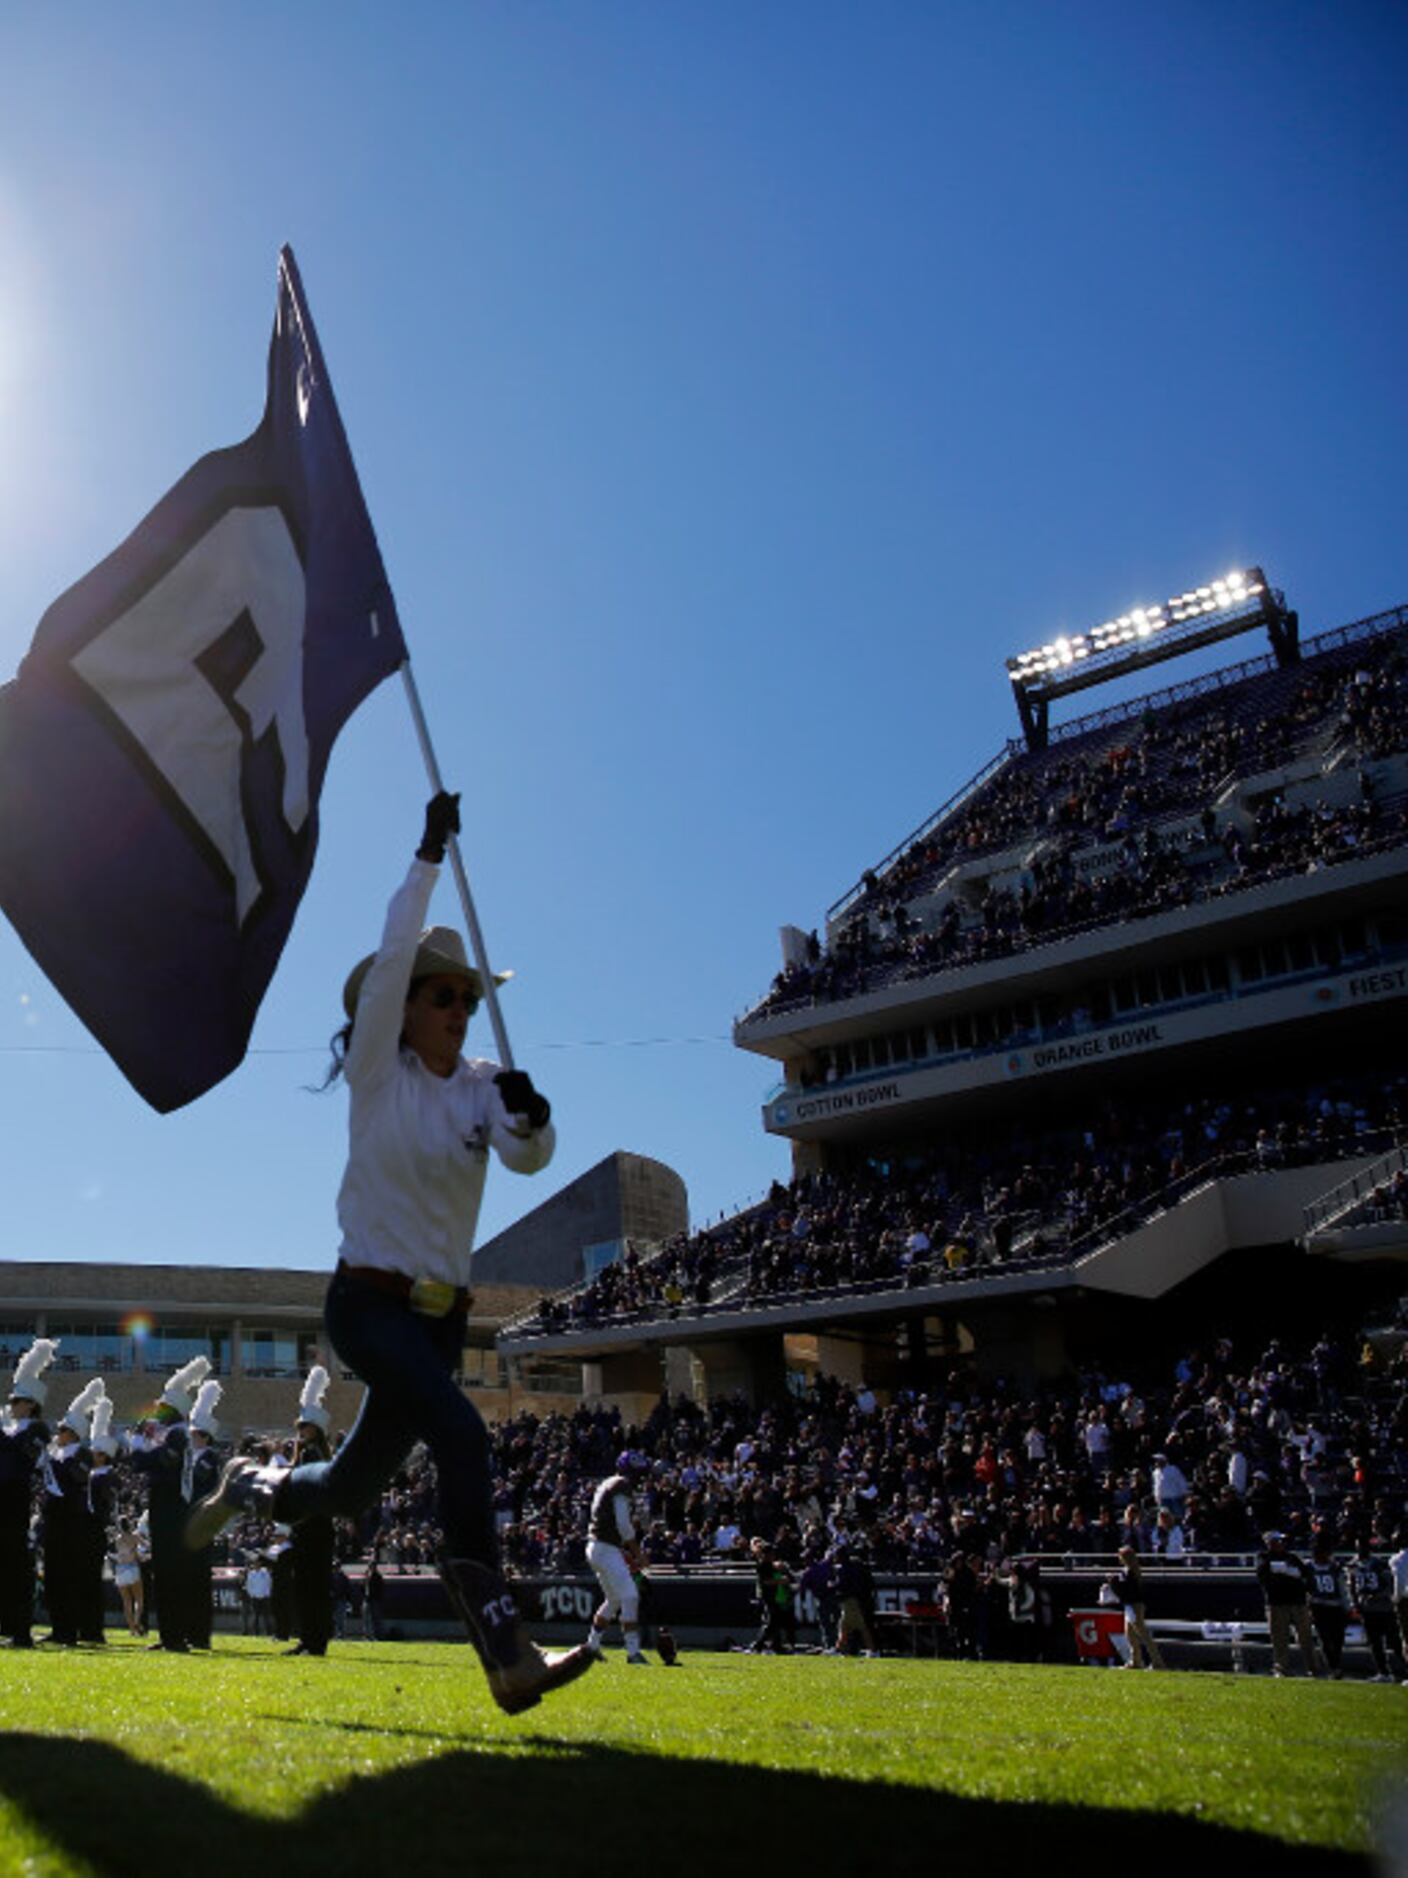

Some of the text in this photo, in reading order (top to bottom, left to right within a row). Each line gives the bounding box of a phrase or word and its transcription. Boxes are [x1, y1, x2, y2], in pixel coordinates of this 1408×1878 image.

[1033, 1025, 1164, 1067] ORANGE BOWL
[796, 1083, 901, 1118] COTTON BOWL
[539, 1585, 592, 1622] TCU
[1077, 1618, 1099, 1645] G
